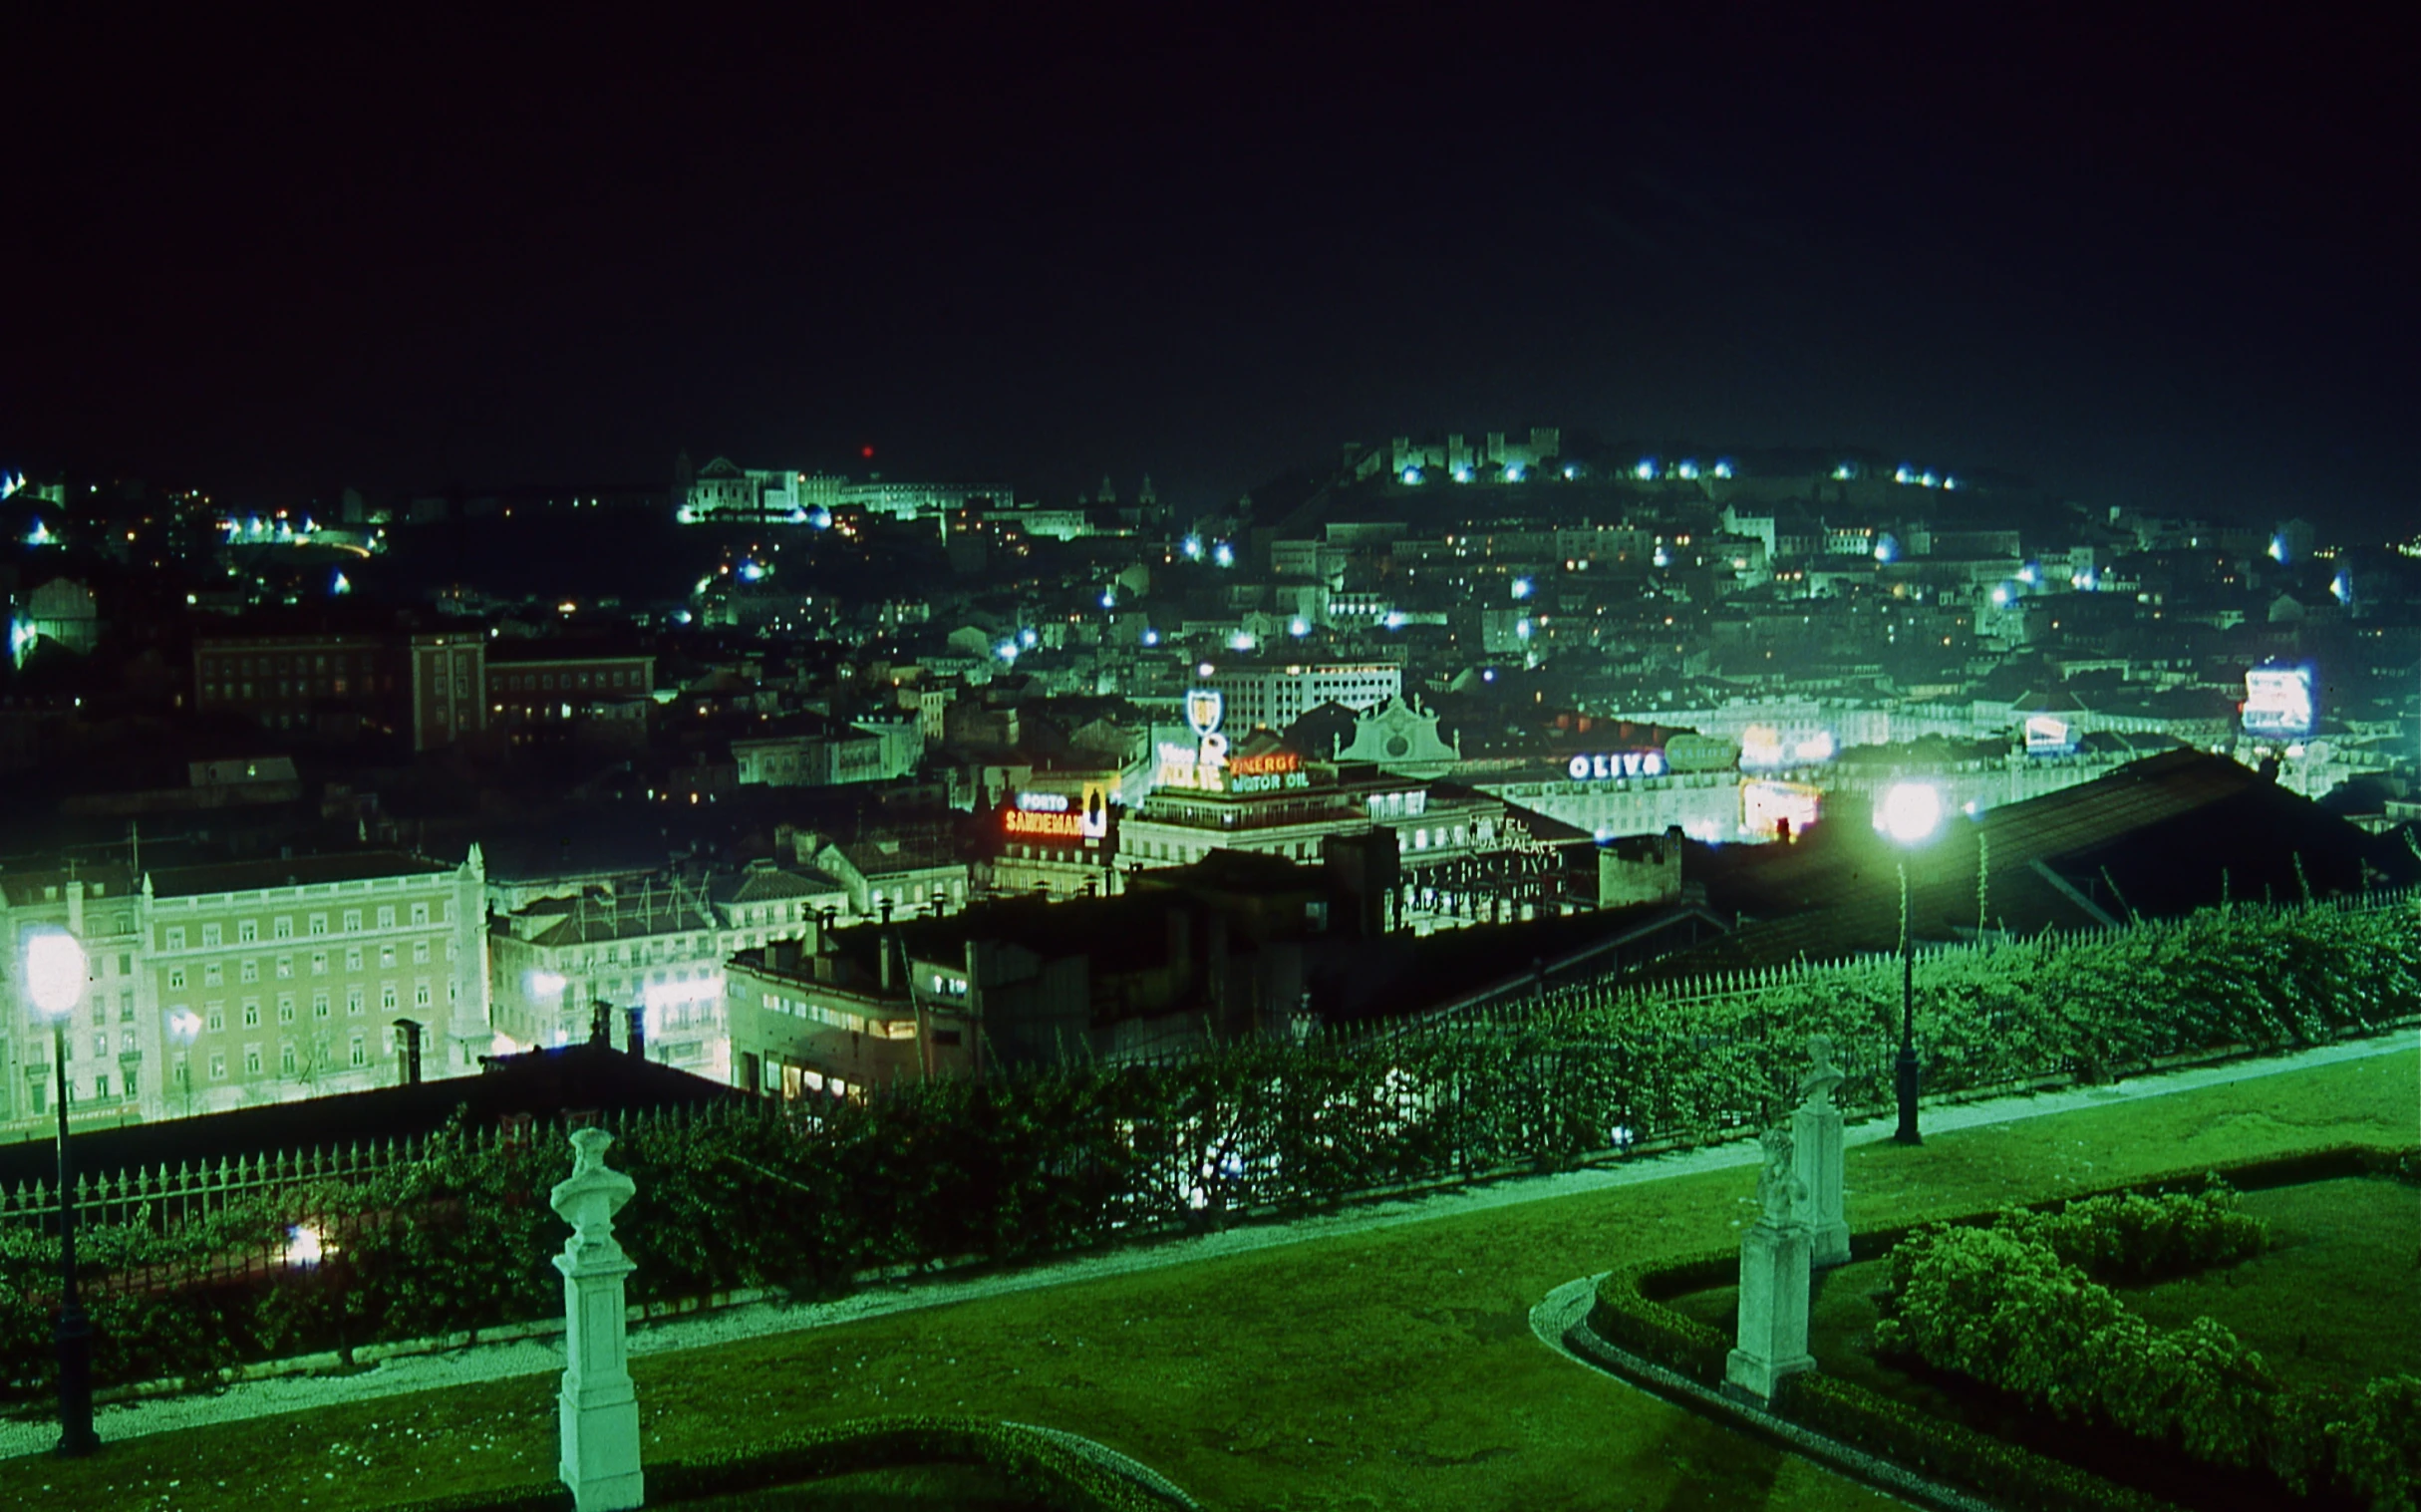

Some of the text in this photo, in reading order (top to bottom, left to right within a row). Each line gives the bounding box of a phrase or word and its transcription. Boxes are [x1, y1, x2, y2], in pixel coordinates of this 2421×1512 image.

[1230, 753, 1305, 775] ENERGO
[1569, 753, 1662, 779] OLIVA
[1232, 771, 1310, 793] MOTOR OIL
[1021, 793, 1068, 811] PORTO
[1006, 810, 1083, 835] SANDEMAN
[1469, 813, 1528, 833] HOTEL
[1503, 835, 1558, 857] PALACE
